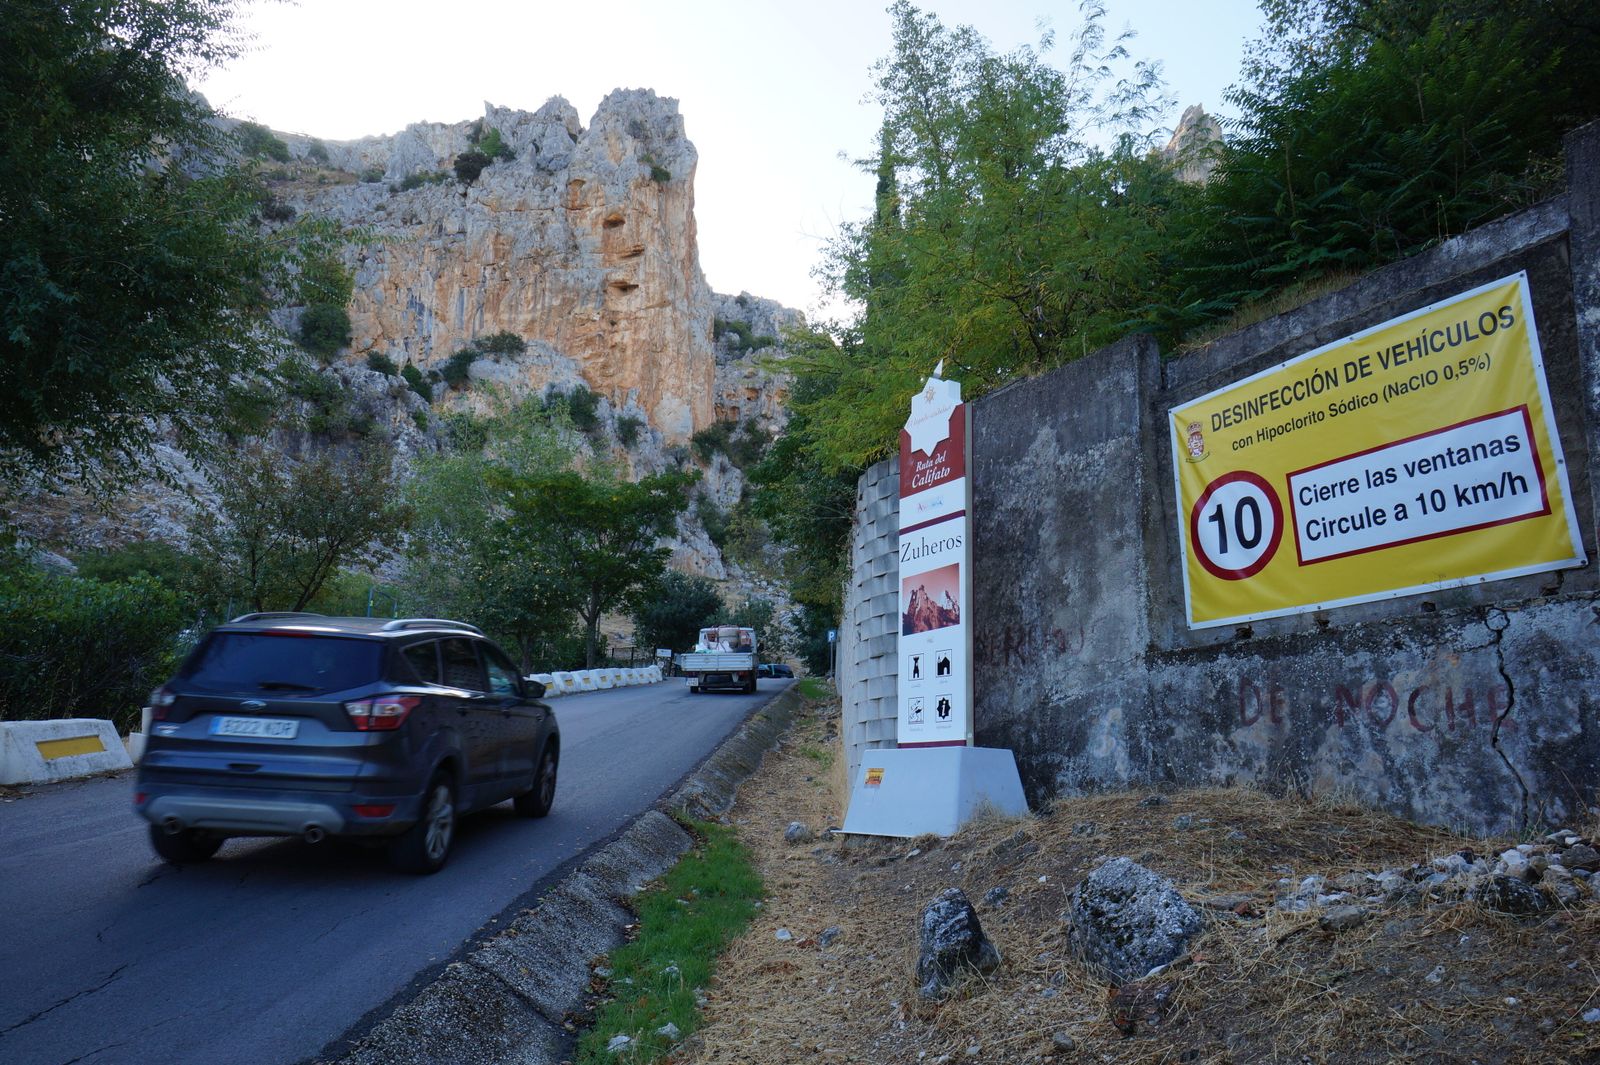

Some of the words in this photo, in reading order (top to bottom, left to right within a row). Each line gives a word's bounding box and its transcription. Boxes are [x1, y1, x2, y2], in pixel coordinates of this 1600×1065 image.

[1211, 367, 1338, 432] DESINFECCIÓN
[1344, 355, 1373, 383] DE
[1377, 305, 1515, 370] VEHÍCULOS
[1232, 435, 1253, 451] con
[1256, 409, 1325, 443] Hipoclorito
[1328, 392, 1378, 418] Sódico
[1443, 352, 1491, 380] 0,5%)
[912, 466, 951, 489] Califato
[916, 460, 933, 472] Ruta
[935, 450, 947, 465] del
[1300, 477, 1359, 506] Cierre
[1365, 467, 1398, 489] las
[1404, 434, 1521, 478] ventanas
[1208, 496, 1262, 554] 10
[1306, 506, 1387, 541] Circule
[1394, 502, 1409, 522] a
[1415, 489, 1446, 516] 10
[1454, 471, 1529, 508] km/h
[900, 535, 963, 563] Zuheros
